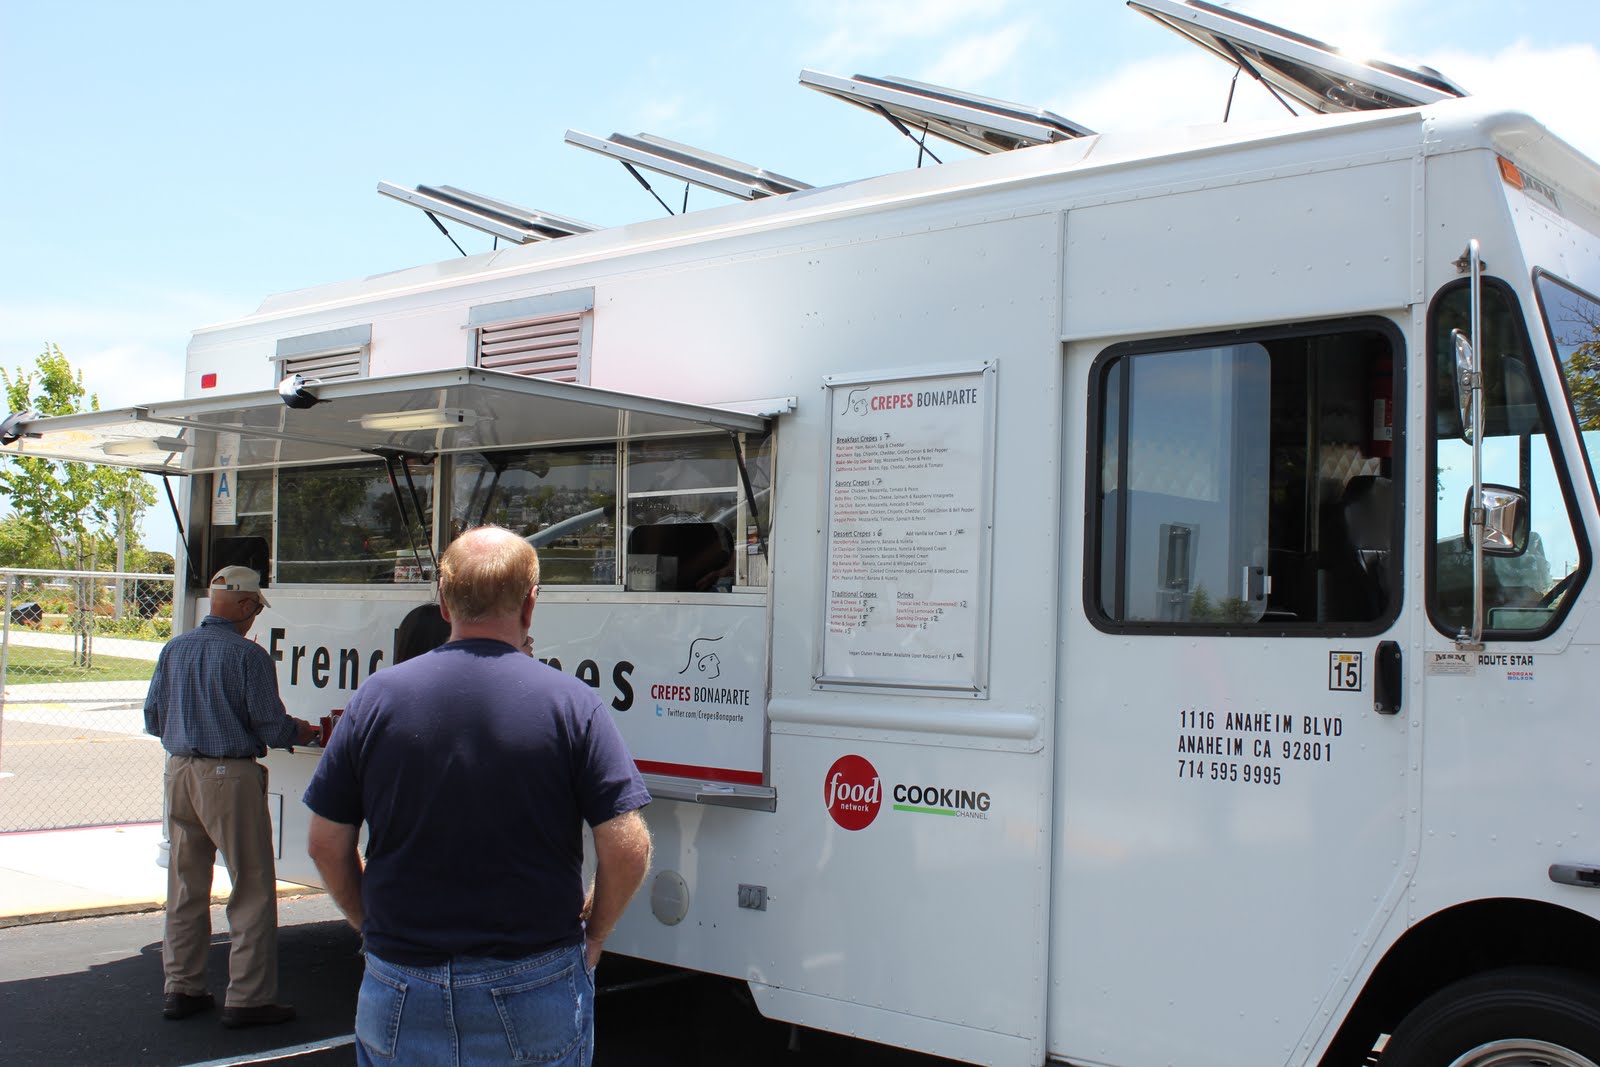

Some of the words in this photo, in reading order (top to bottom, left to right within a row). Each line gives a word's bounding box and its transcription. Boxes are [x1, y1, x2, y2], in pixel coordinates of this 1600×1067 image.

[871, 393, 913, 411] CREPES
[917, 388, 977, 408] BONAPARTE
[860, 435, 877, 443] Crepes
[217, 472, 230, 498] A
[835, 480, 851, 488] Savory
[852, 479, 870, 487] Crepes
[859, 591, 877, 599] Crepes
[270, 628, 399, 690] Frenc
[1435, 654, 1466, 662] MSM
[1478, 655, 1508, 665] ROUTE
[1510, 656, 1534, 666] STAR
[1334, 662, 1357, 688] 15
[651, 684, 691, 702] CREPES
[694, 687, 750, 706] BONAPARTE
[667, 708, 744, 722] Twitter.com/CrepesBonaparte
[1181, 710, 1214, 730] 1116
[1226, 712, 1292, 734] ANAHEIM
[1304, 716, 1342, 736] BLVD
[1178, 735, 1242, 756] ANAHEIM
[1254, 740, 1272, 758] CA
[1283, 741, 1330, 762] 92801
[1178, 760, 1204, 778] 714
[1211, 762, 1237, 782] 595
[1244, 764, 1280, 785] 9995
[828, 772, 880, 810] food
[894, 784, 990, 812] COOKING
[841, 803, 869, 812] network
[956, 810, 988, 820] CHANNEL
